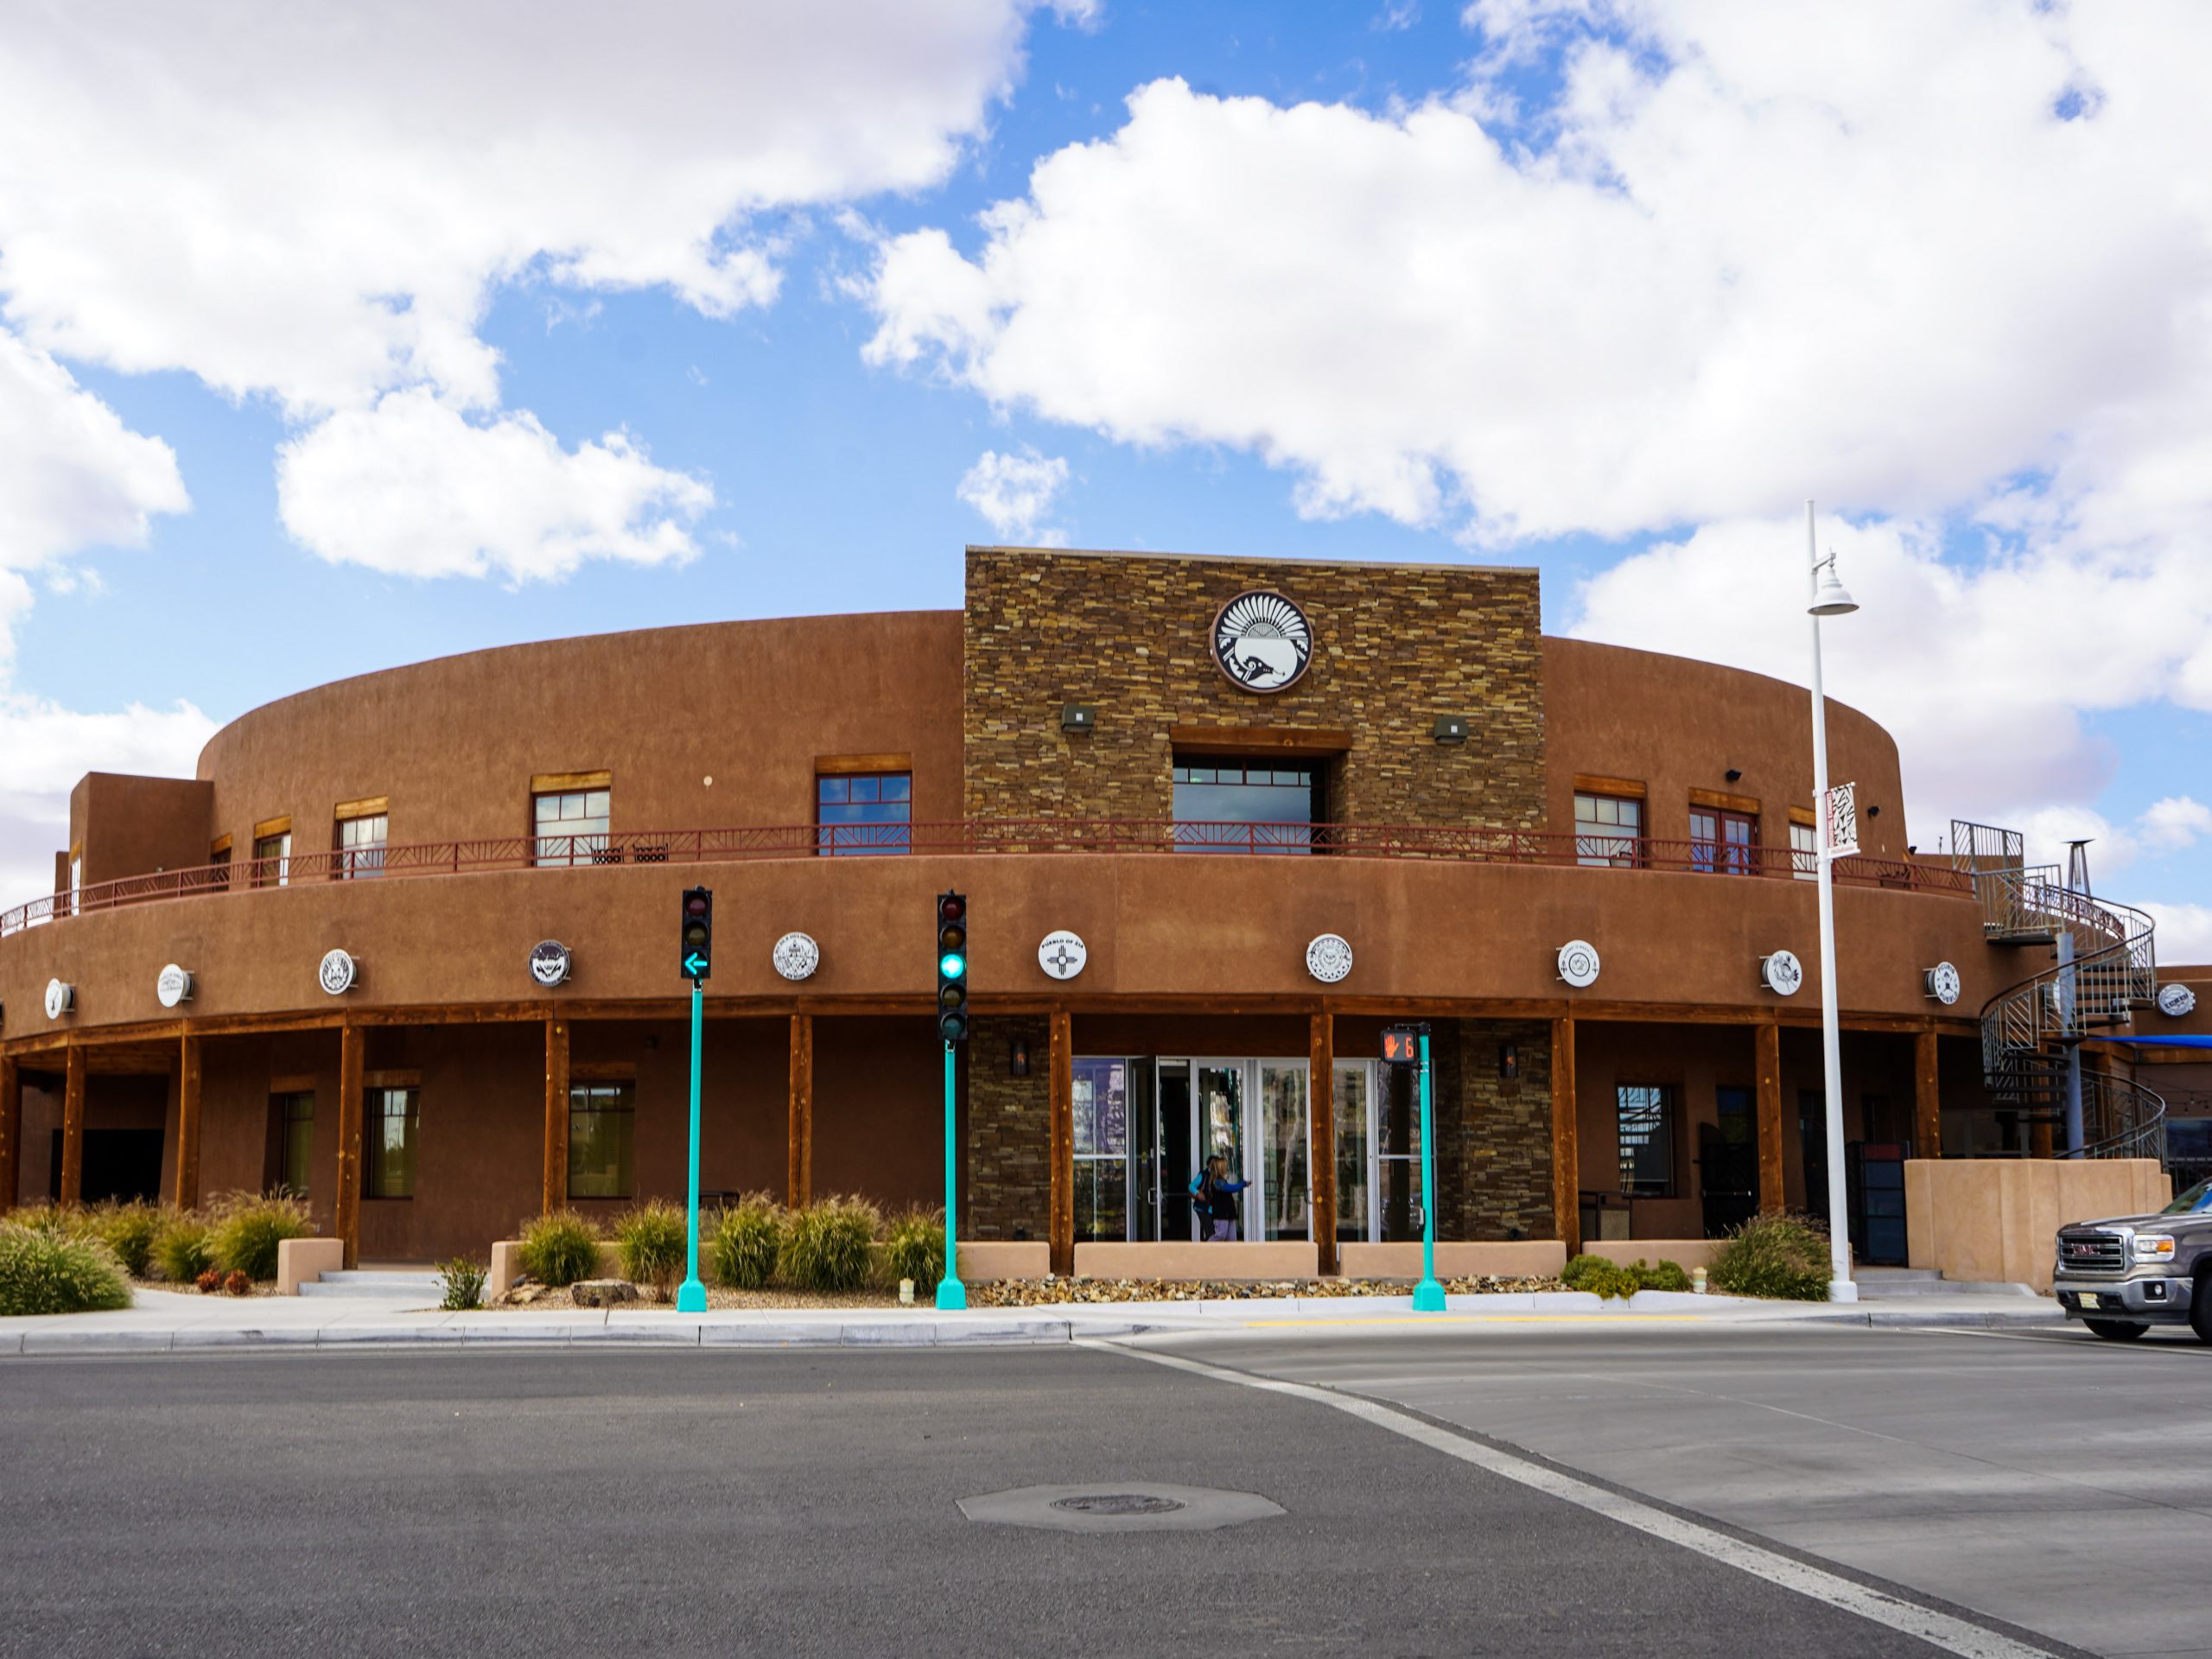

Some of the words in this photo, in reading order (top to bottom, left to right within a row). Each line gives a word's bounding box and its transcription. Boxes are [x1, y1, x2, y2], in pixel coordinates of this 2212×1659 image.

[1041, 938, 1065, 950] PUEBLO
[1405, 1036, 1414, 1058] 6
[2073, 1244, 2100, 1255] GMC
